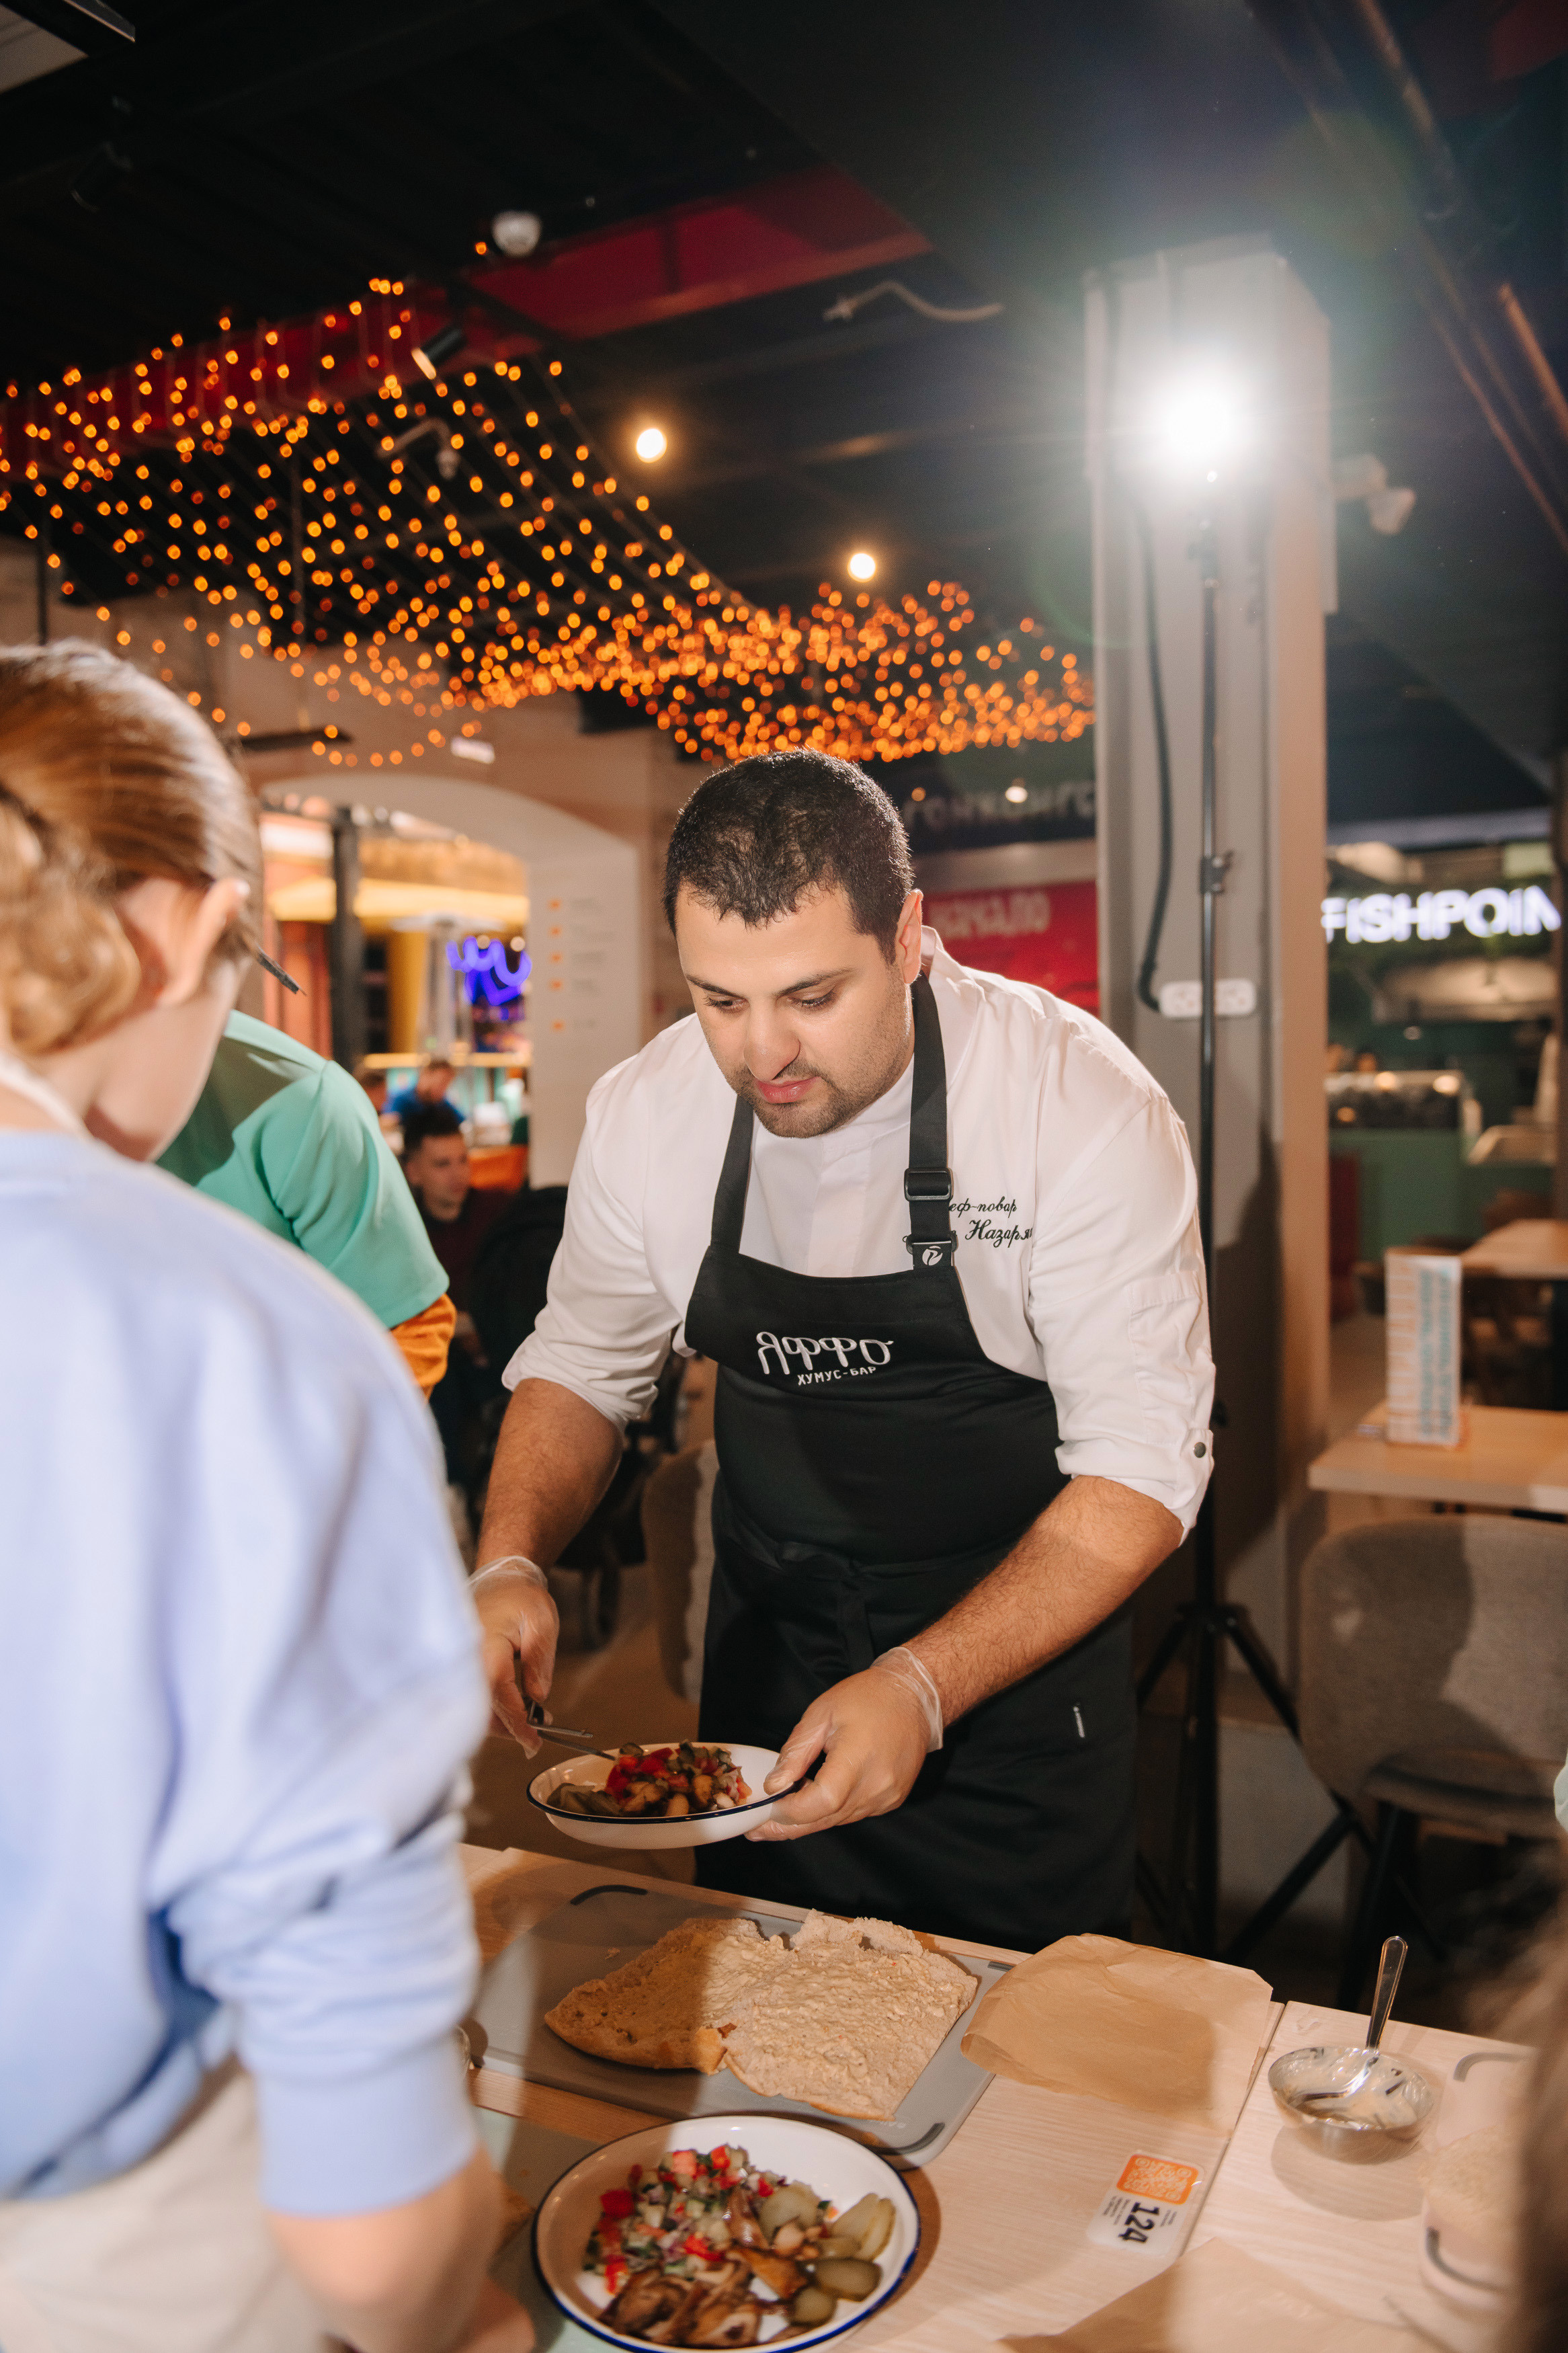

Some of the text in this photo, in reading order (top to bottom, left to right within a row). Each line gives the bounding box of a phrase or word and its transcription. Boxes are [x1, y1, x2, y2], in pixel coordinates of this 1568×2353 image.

[949, 1196, 1018, 1218] еф-повар
[798, 1366, 876, 1386] ХУМУС-БАР
[1118, 2202, 1159, 2243] 124
